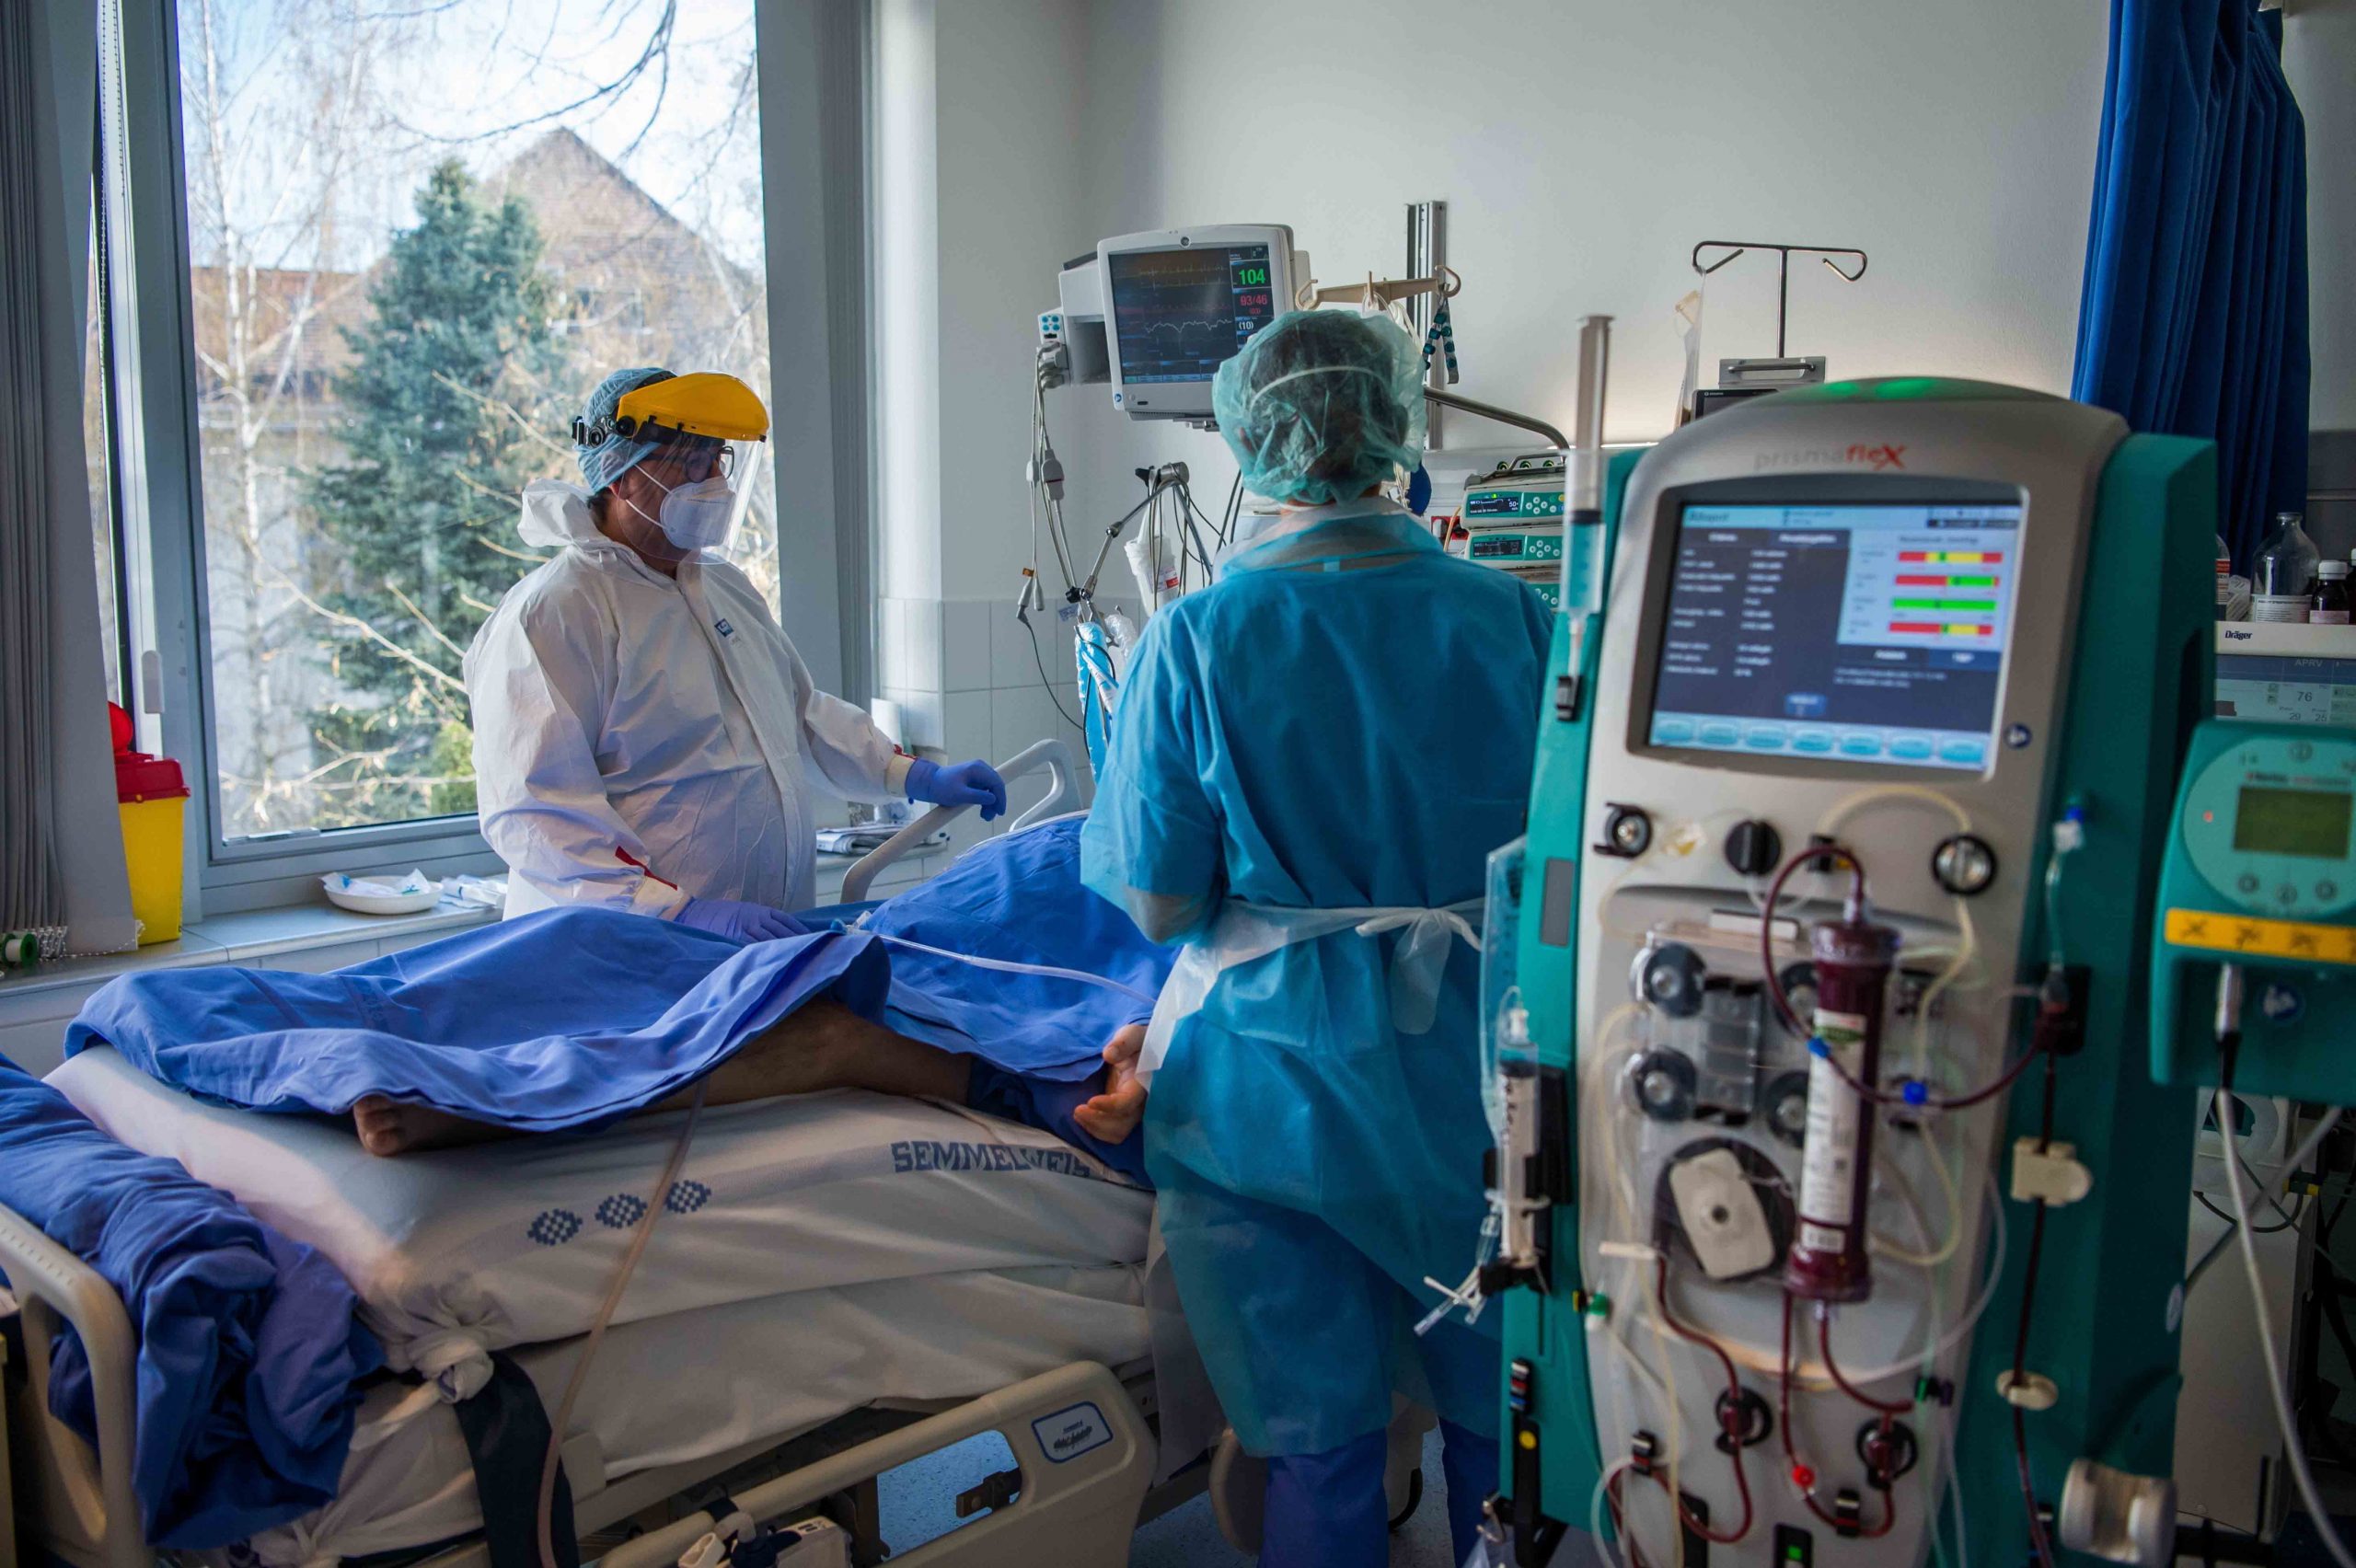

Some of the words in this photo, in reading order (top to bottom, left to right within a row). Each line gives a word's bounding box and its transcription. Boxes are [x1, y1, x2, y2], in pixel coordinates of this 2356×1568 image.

[1239, 269, 1266, 285] 104
[1239, 321, 1254, 331] (10)
[2224, 630, 2253, 640] Dräger
[2294, 659, 2323, 668] APRV
[2297, 691, 2313, 702] 76
